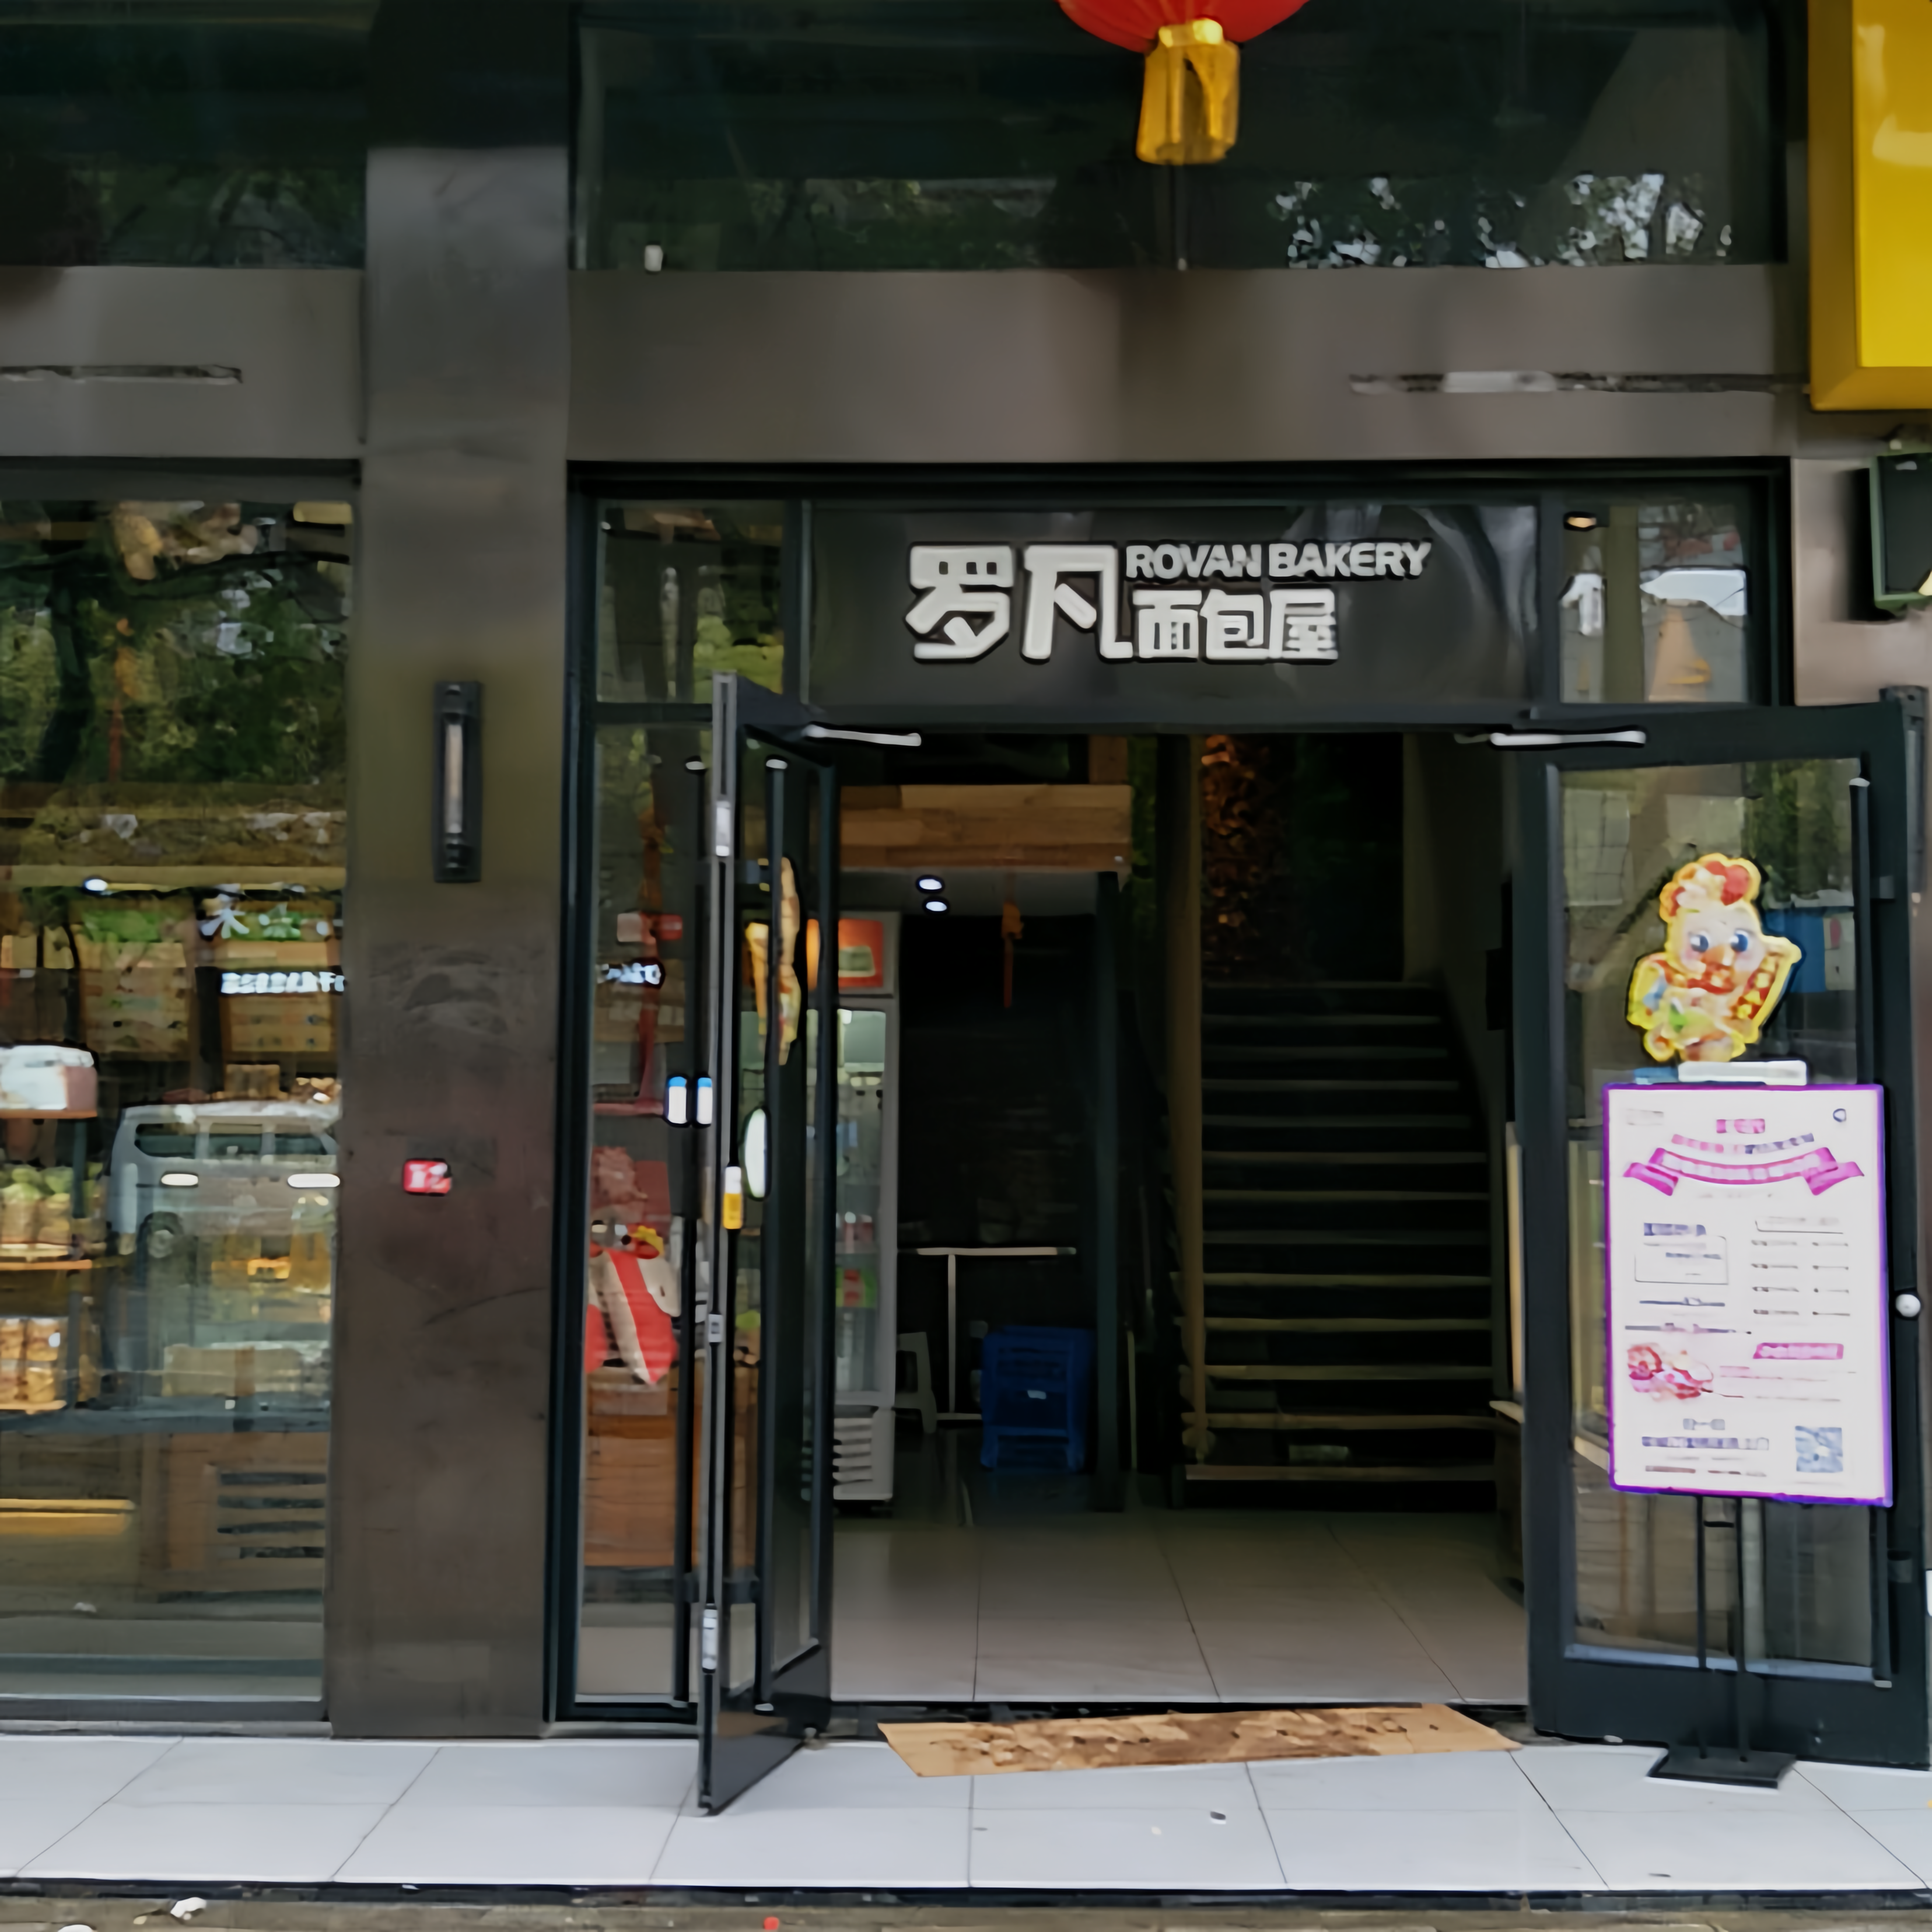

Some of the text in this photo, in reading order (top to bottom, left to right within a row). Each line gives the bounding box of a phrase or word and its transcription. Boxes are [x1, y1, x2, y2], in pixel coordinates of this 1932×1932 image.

[1126, 542, 1432, 579] ROVAN BAKERY
[905, 545, 1133, 659] 罗凡
[1133, 589, 1338, 659] 面包屋
